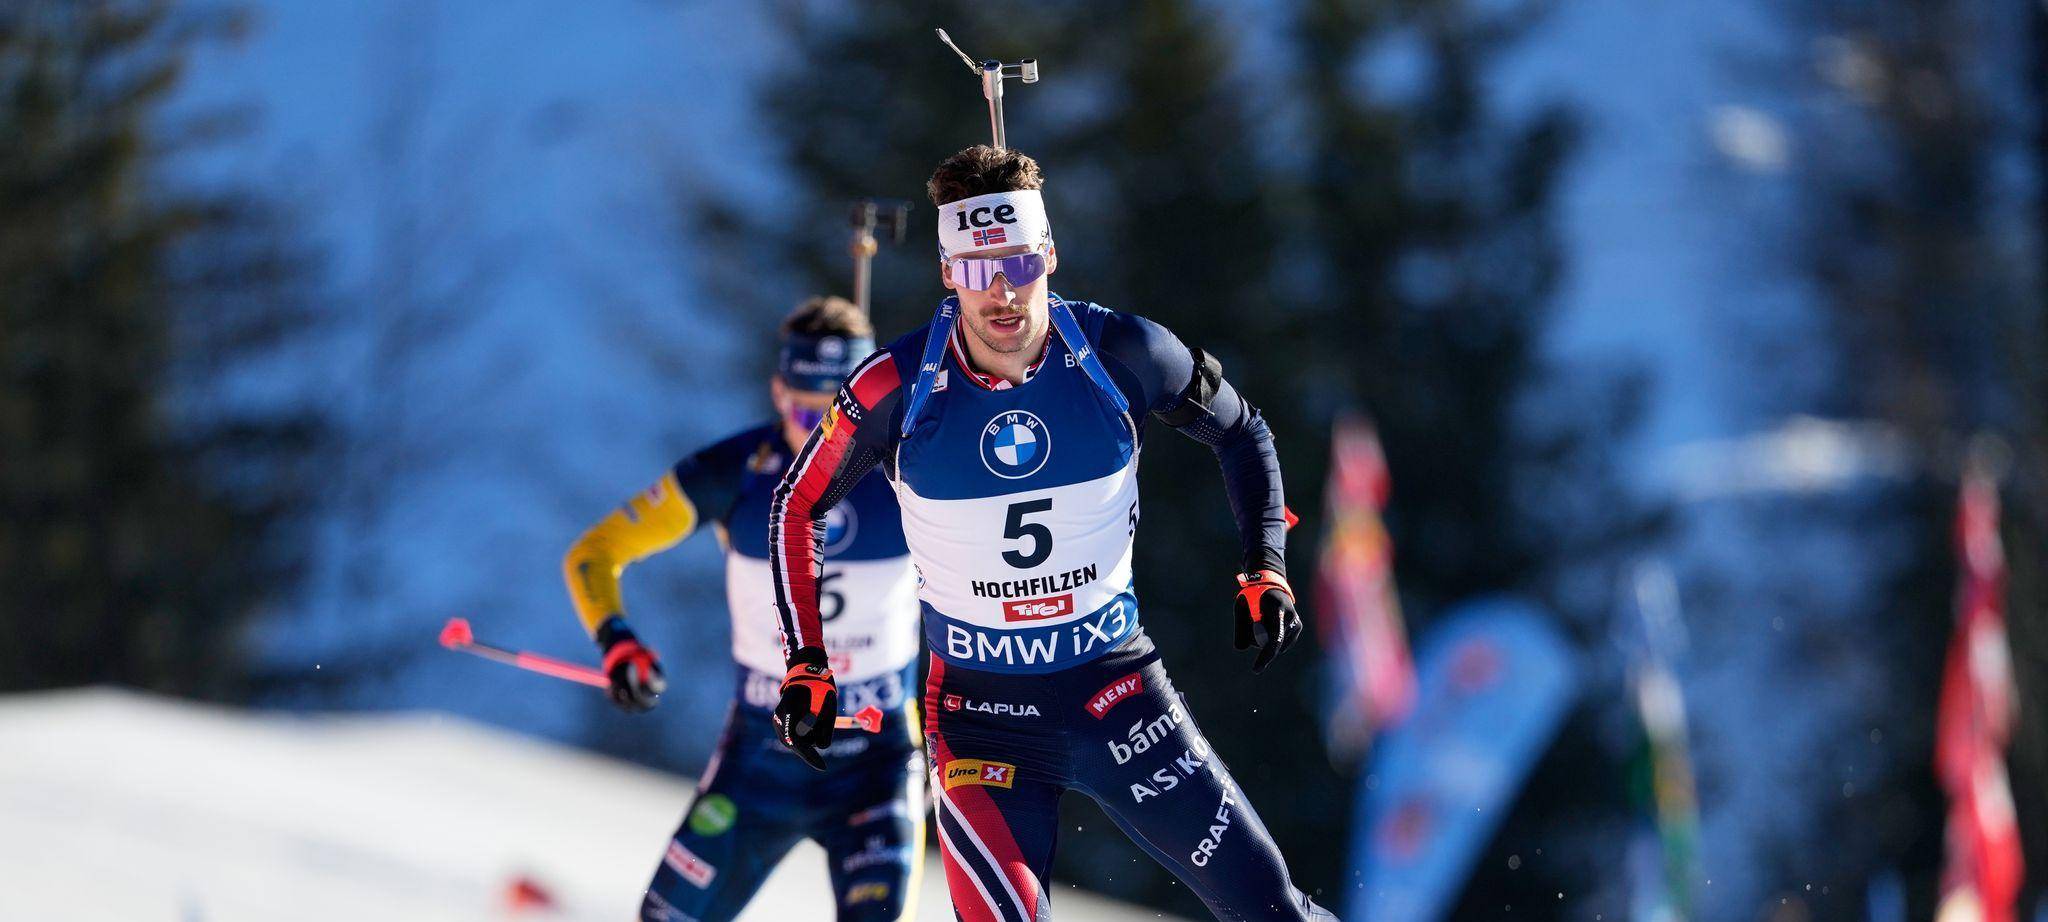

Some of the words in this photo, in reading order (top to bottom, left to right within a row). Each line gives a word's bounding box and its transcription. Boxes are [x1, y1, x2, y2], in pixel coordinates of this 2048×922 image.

[957, 204, 1017, 231] ice
[987, 413, 1039, 436] BMW
[1001, 497, 1053, 569] 5
[971, 562, 1098, 599] HOCHFILZEN
[946, 623, 1060, 665] BMW
[1072, 600, 1128, 657] iX3
[965, 699, 1042, 717] LAPUA
[1092, 678, 1138, 713] MENY
[948, 767, 978, 779] Uno
[984, 766, 1007, 782] X
[1190, 789, 1236, 868] CRAFT
